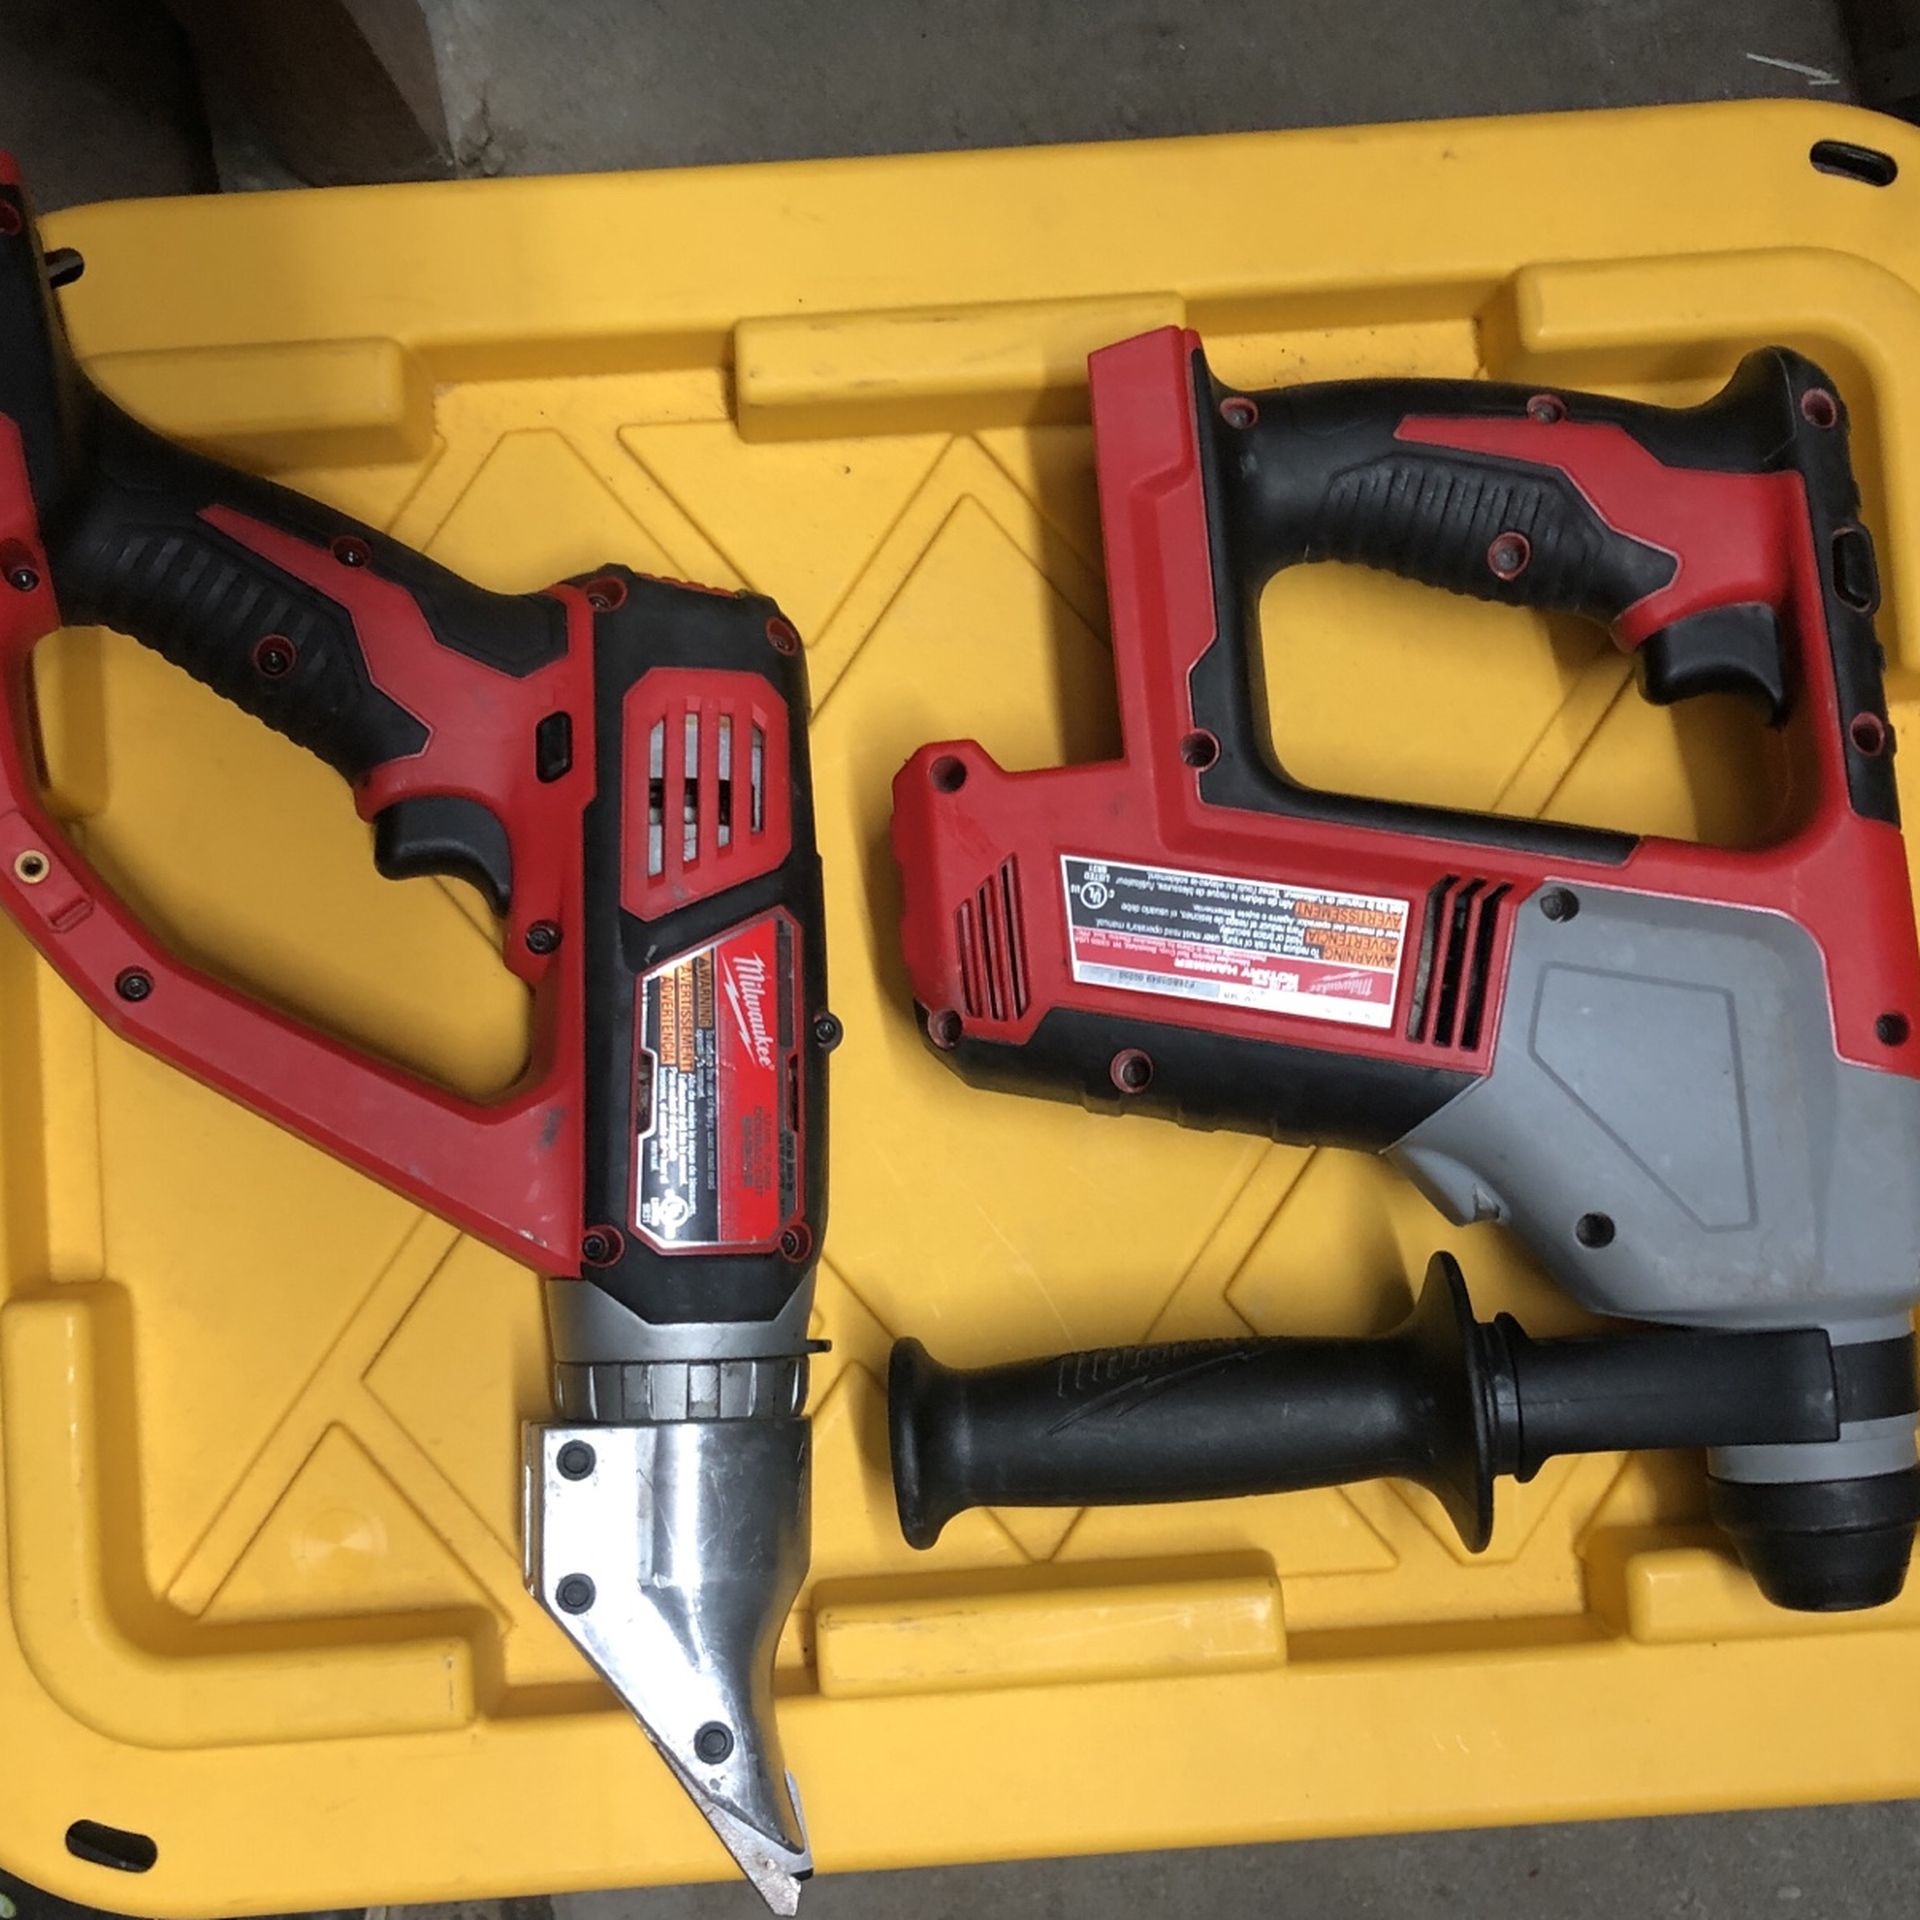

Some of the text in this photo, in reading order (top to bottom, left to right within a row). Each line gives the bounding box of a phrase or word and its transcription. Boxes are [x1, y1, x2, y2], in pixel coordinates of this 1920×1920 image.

[1294, 901, 1401, 928] AVERTISSEMENT
[1306, 928, 1397, 955] ADVERTENCIA
[1324, 947, 1384, 967] WARNING
[1173, 956, 1238, 975] HAMMER
[698, 967, 711, 1025] WARNING
[732, 952, 773, 1066] Milwaukee
[660, 976, 676, 1061] ADVERTENCIA
[679, 965, 693, 1070] AVERTISSEMENT
